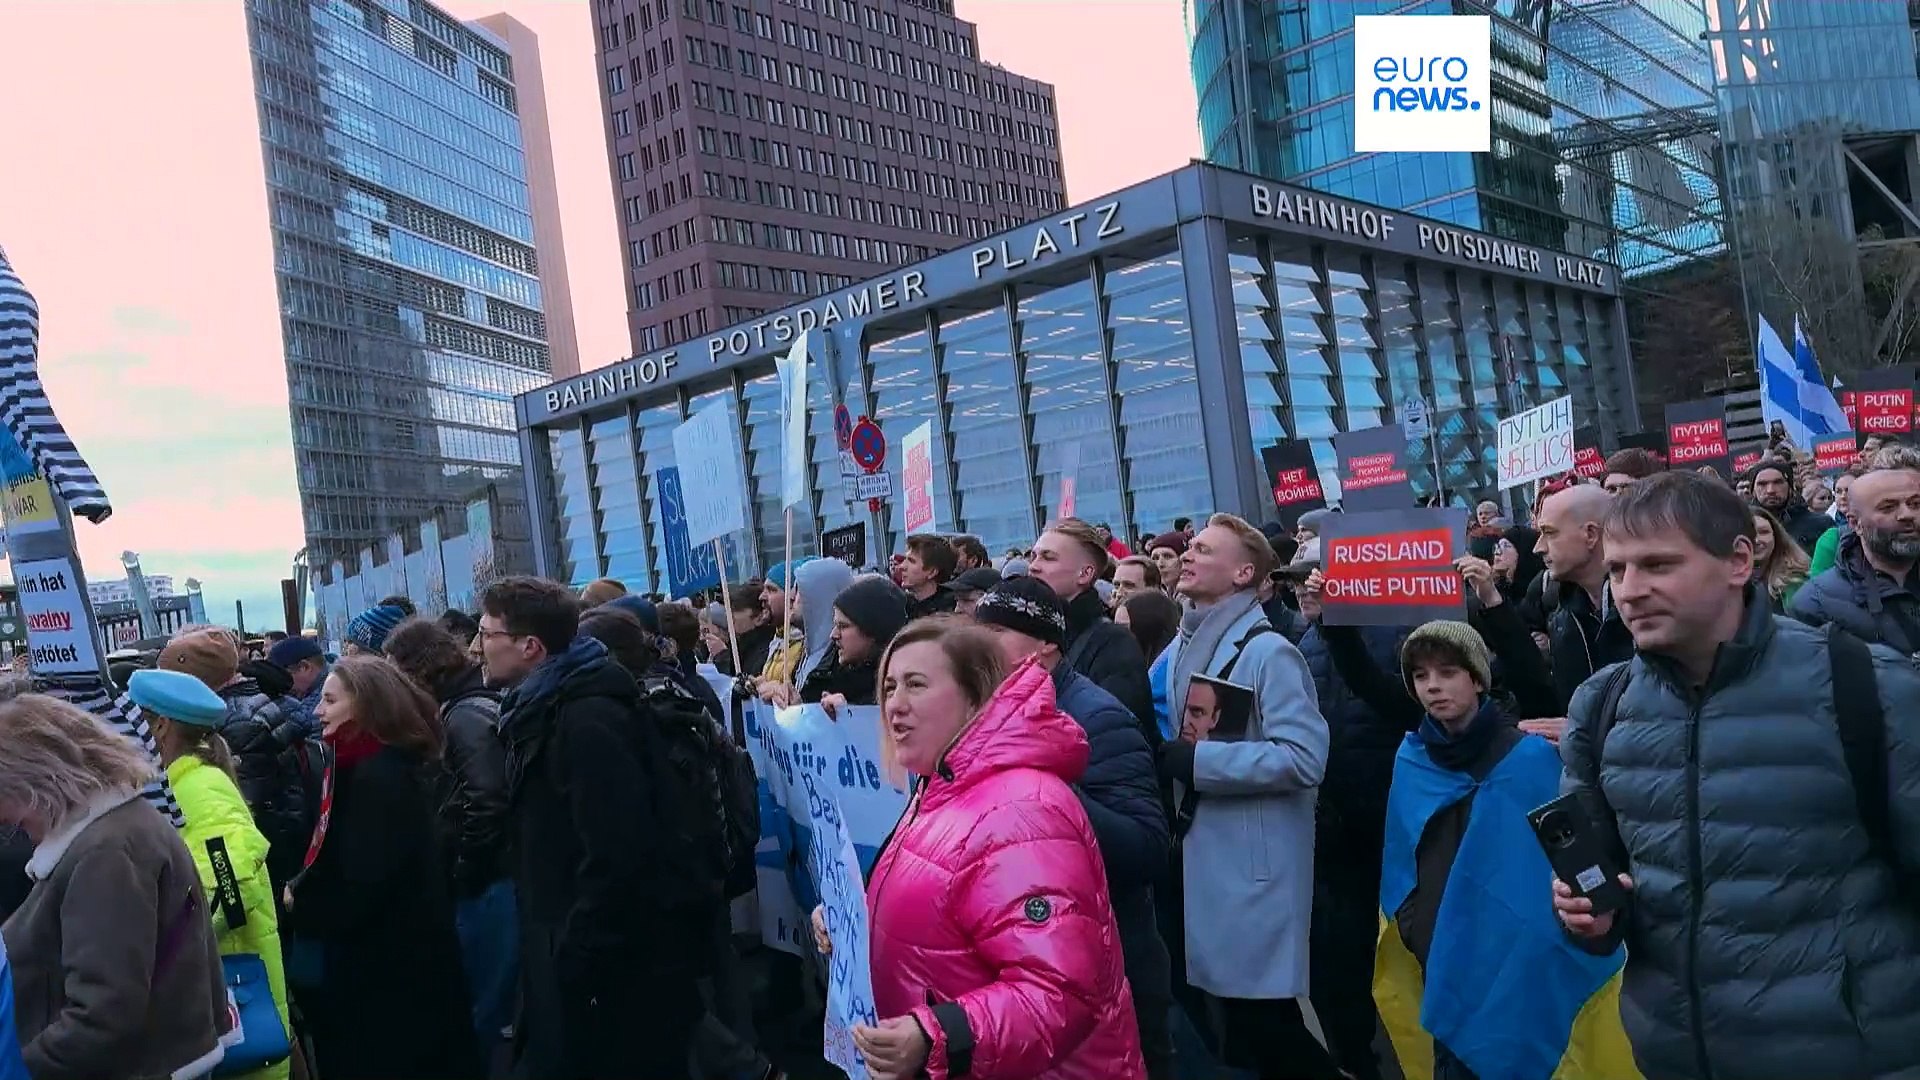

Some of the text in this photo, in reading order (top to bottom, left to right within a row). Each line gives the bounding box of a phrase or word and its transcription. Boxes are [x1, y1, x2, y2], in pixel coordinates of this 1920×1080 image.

[1251, 183, 1605, 287] BAHNHOF POTSDAMER PLATZ
[545, 201, 1124, 413] BAHNHOF POTSDAMER PLATZ
[1864, 393, 1905, 407] PUTIN
[1675, 421, 1718, 438] ПУТИН
[1864, 415, 1907, 428] KRIEG
[1674, 442, 1722, 458] ВОЙНА
[1819, 441, 1856, 453] RUSSL
[1282, 469, 1304, 484] НЕТ
[1277, 484, 1320, 502] ВОЙНЕ!
[832, 532, 857, 549] PUTIN
[1334, 540, 1445, 564] RUSSLAND
[39, 571, 67, 592] hat
[1325, 576, 1457, 597] OHNE PUTIN!
[28, 608, 71, 631] avalny
[793, 741, 827, 777] für
[838, 744, 881, 791] die
